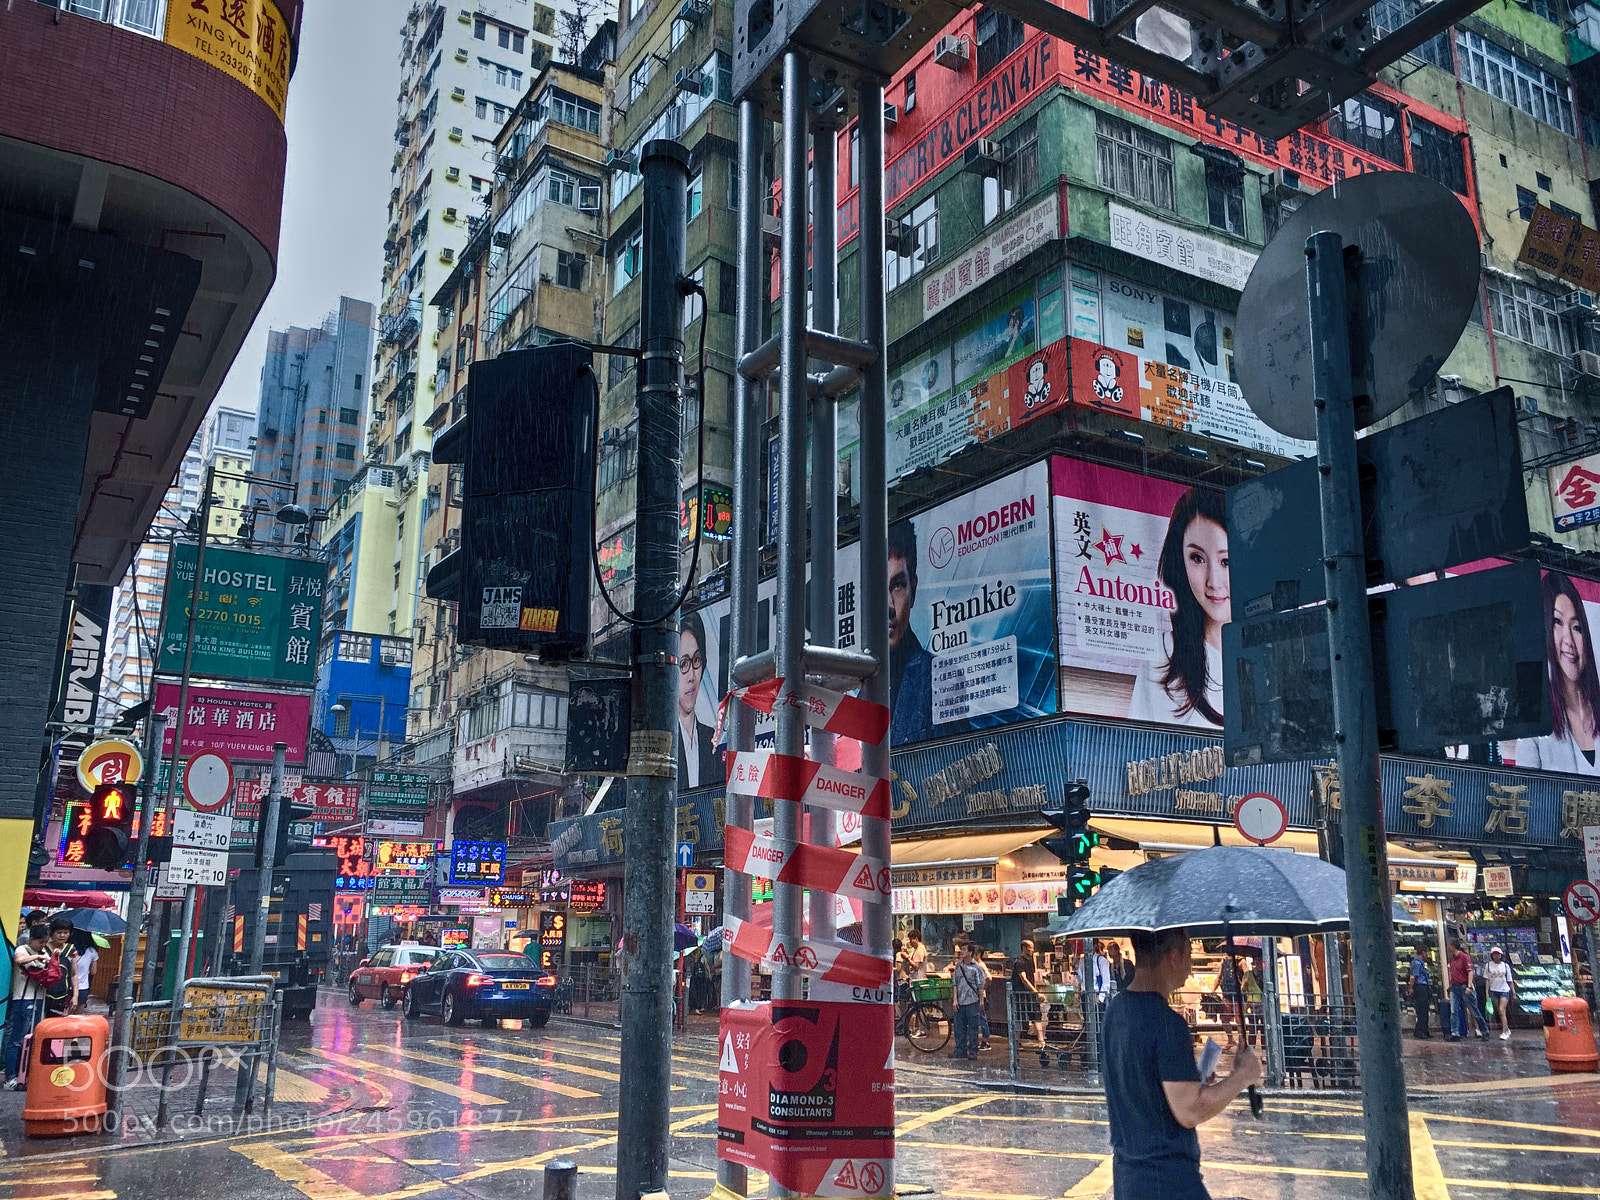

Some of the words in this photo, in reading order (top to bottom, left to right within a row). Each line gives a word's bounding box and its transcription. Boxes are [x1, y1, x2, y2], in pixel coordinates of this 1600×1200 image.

[187, 13, 225, 42] XING
[228, 35, 262, 68] YUAN
[1020, 37, 1050, 93] 4/F
[940, 121, 953, 158] &
[956, 66, 1017, 145] CLEAN
[1113, 213, 1195, 269] 旺角賓館
[1110, 281, 1157, 304] SONY
[1167, 384, 1212, 409] 歡迎試聽
[957, 494, 1036, 546] MODERN
[957, 533, 1000, 558] EDUCATION
[1073, 511, 1092, 560] 英文
[1102, 540, 1118, 559] 補
[177, 560, 197, 571] SIN
[204, 568, 277, 592] HOSTEL
[1074, 565, 1176, 610] Antonia
[483, 588, 522, 604] JAMS
[931, 580, 1017, 631] Frankie
[198, 609, 228, 621] 2770
[233, 613, 261, 625] 1015
[285, 602, 315, 666] 賓館
[931, 630, 968, 653] Chan
[197, 643, 217, 652] YUEN
[219, 645, 236, 654] KING
[238, 648, 271, 657] BUILDING
[782, 690, 827, 717] 危險
[226, 742, 246, 750] YUEN
[734, 763, 759, 782] 危險
[1127, 746, 1225, 796] HOLLYWOOD
[816, 777, 866, 800] DANGER
[216, 834, 227, 845] 10
[752, 845, 785, 864] DANGER
[213, 870, 224, 882] 10
[553, 915, 564, 930] $
[770, 1092, 834, 1106] DIAMOND-3
[770, 1105, 832, 1118] CONSULTANTS
